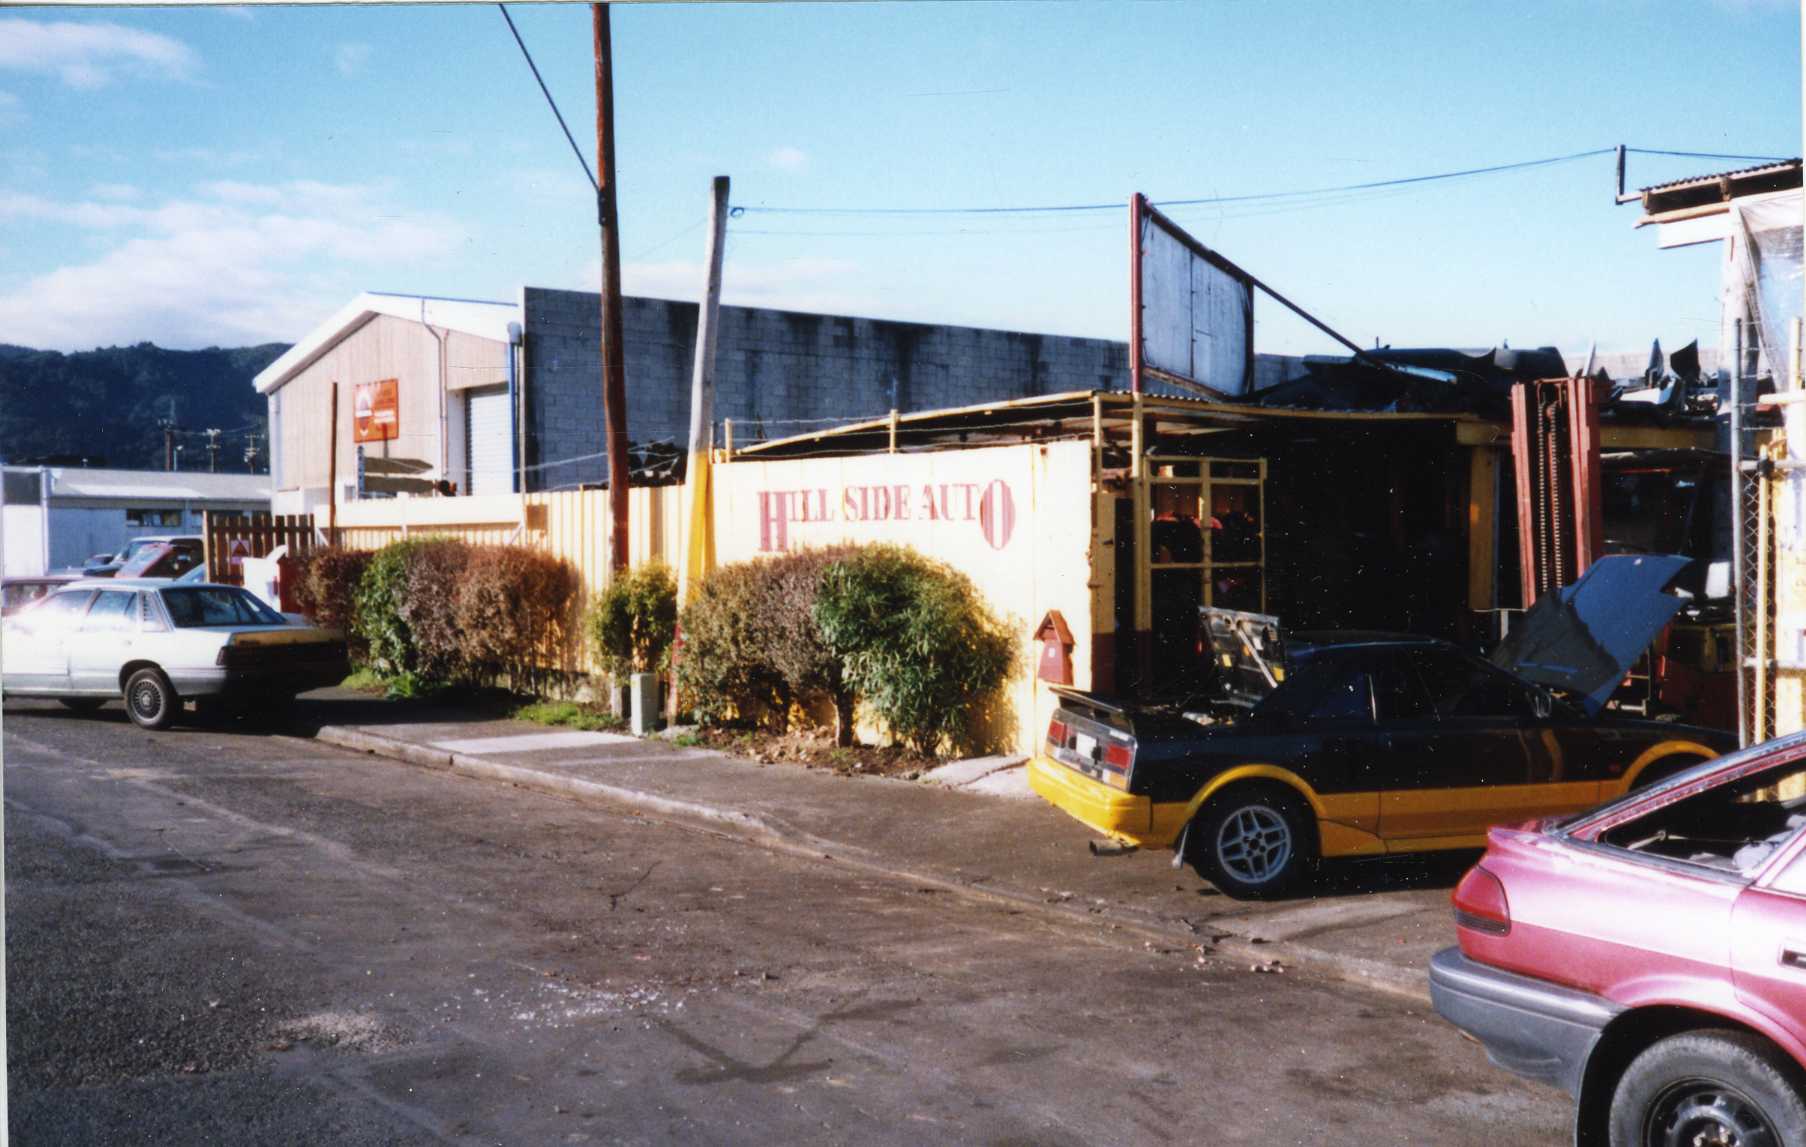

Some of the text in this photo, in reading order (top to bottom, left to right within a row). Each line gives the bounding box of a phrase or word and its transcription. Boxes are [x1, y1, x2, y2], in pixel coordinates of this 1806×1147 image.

[758, 479, 1015, 551] HILL SIDE AUTO
